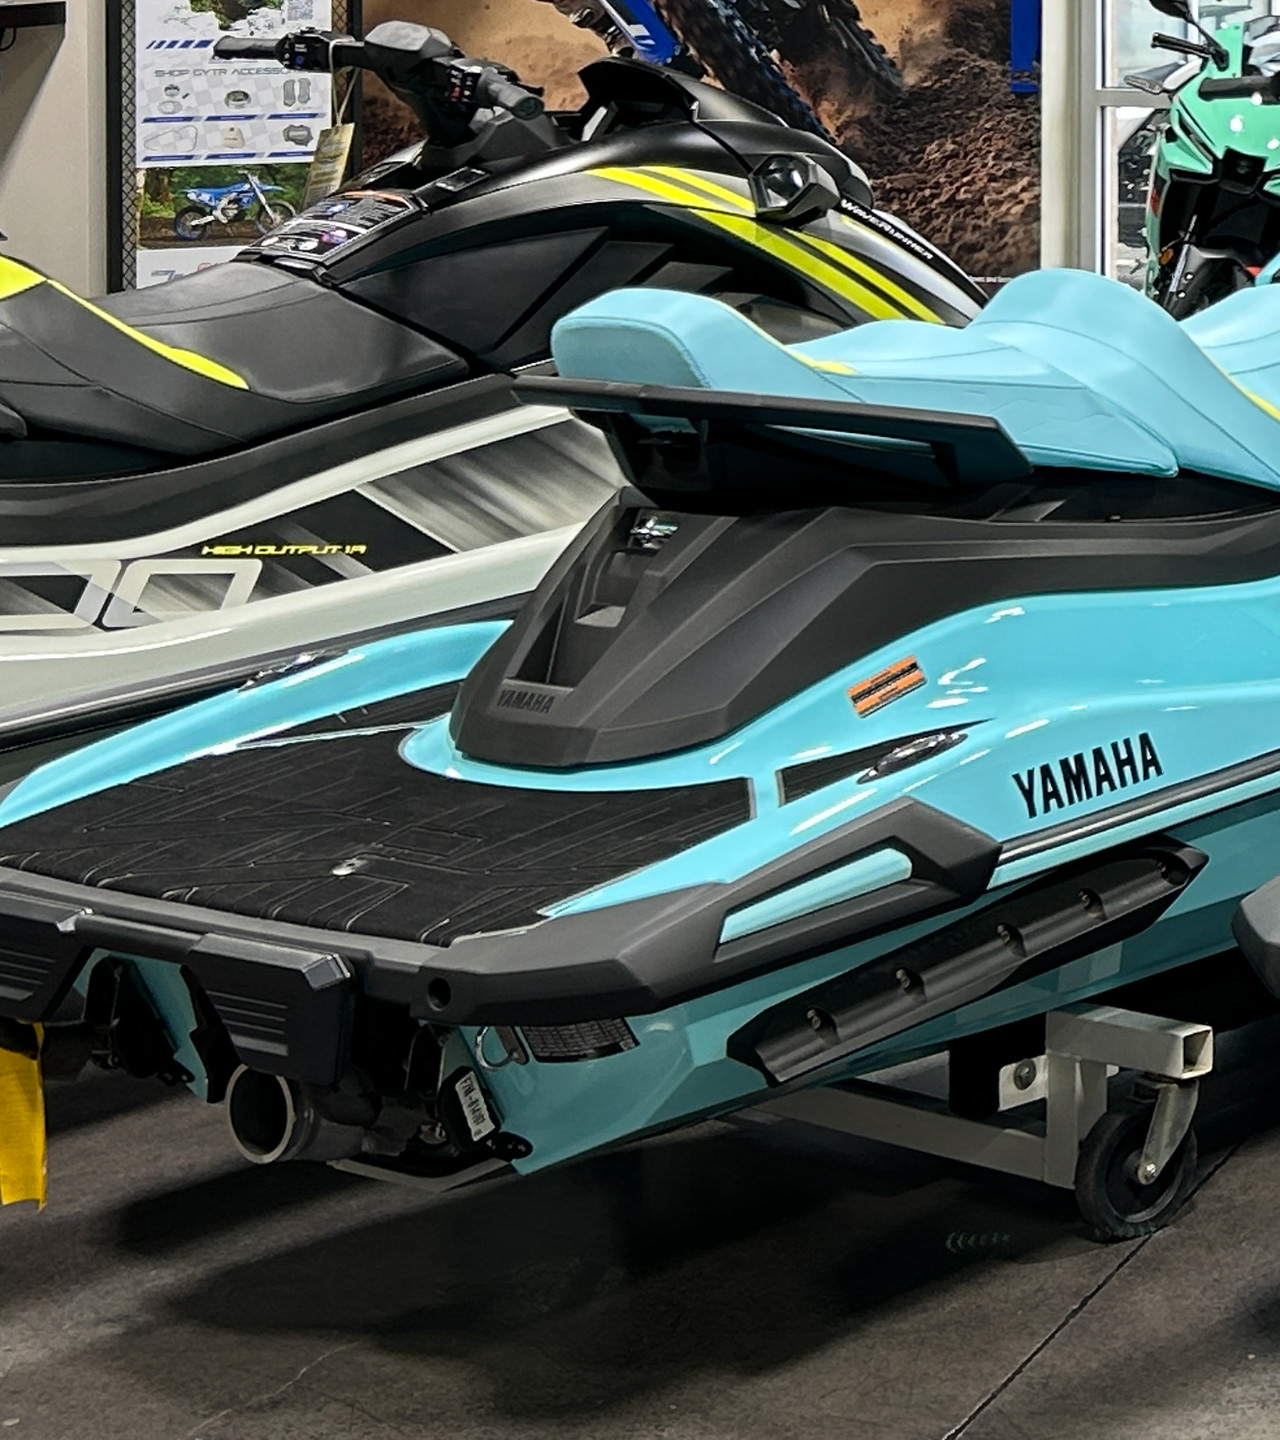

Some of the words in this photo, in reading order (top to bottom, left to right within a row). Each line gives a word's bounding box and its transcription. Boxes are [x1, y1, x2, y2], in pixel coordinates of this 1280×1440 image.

[155, 69, 190, 77] SHOP
[193, 68, 227, 77] GYTR
[254, 544, 342, 555] OUTPUT
[497, 689, 556, 713] YAMAHA
[1012, 732, 1165, 819] YAMAHA
